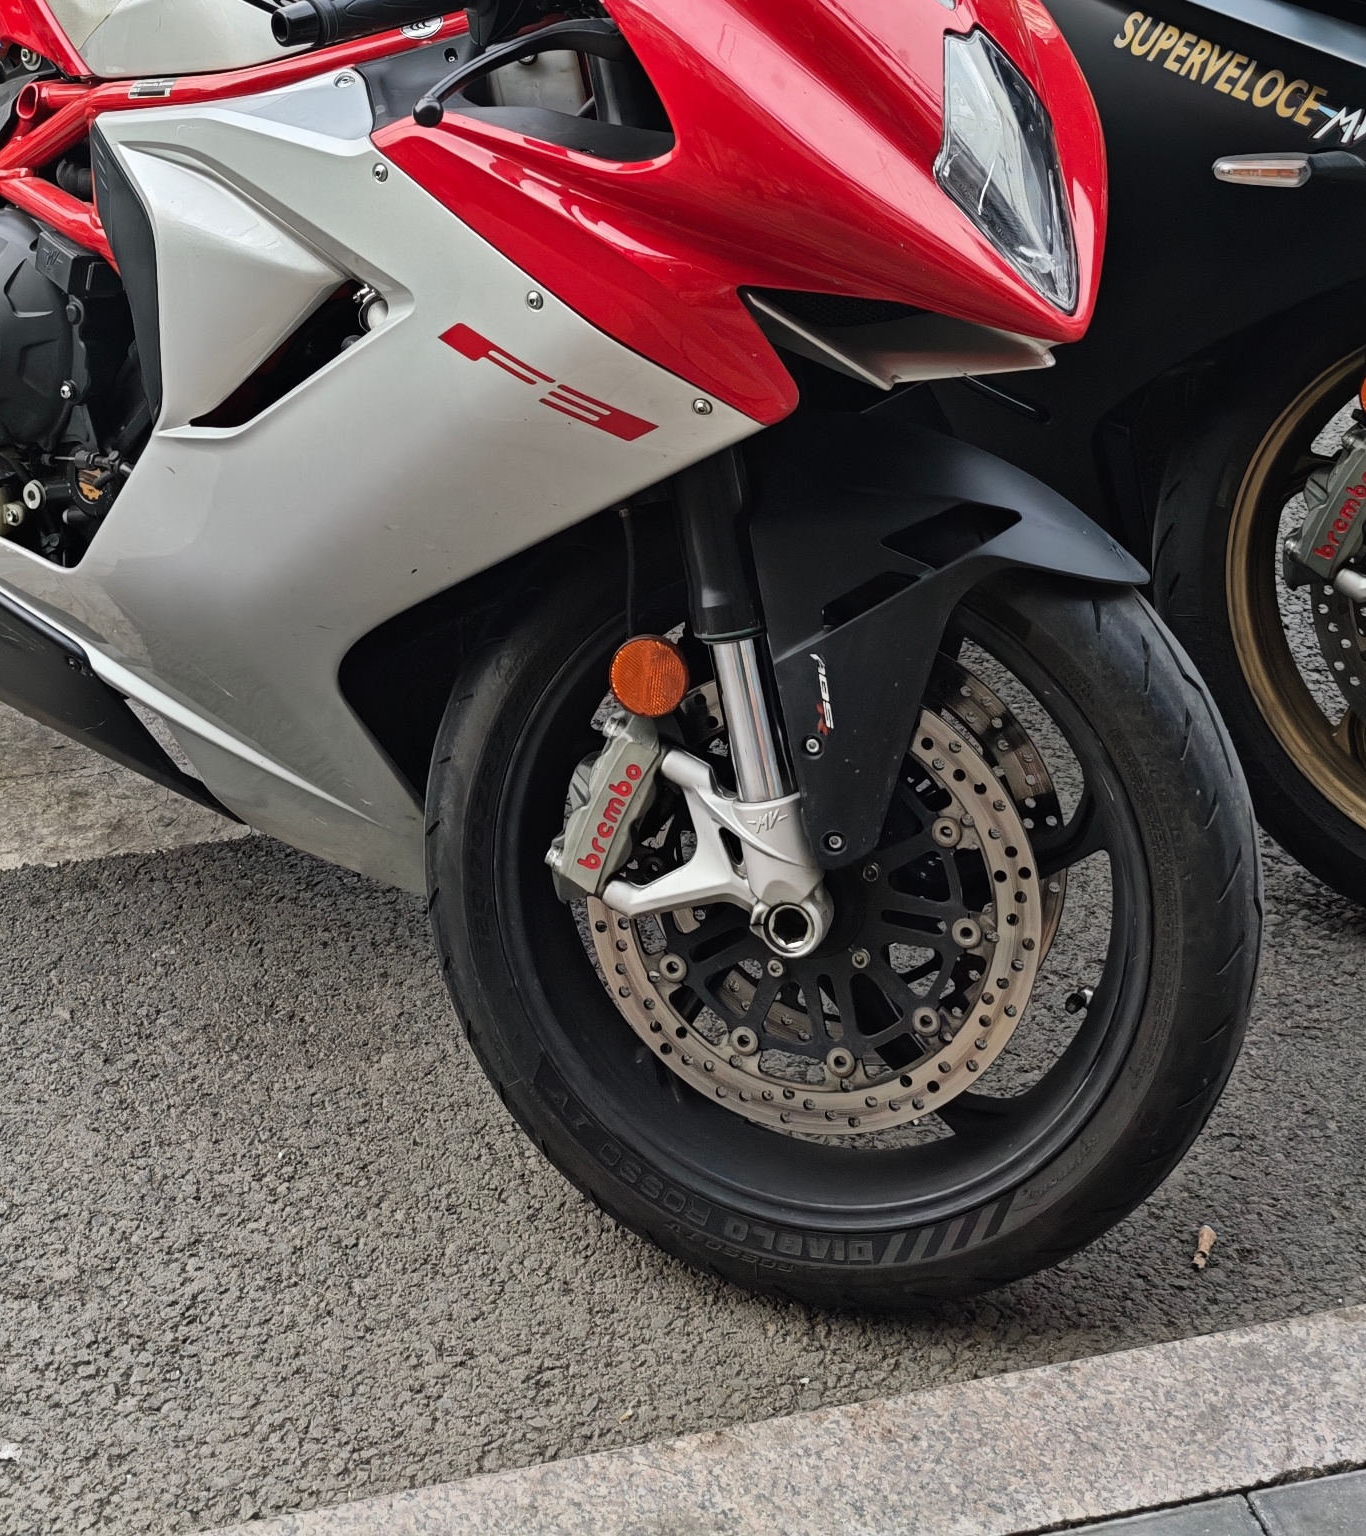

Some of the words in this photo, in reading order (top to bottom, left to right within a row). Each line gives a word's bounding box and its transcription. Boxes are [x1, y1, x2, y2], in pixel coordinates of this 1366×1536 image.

[1113, 10, 1328, 127] SUPERVELOCE
[436, 322, 660, 442] F3
[576, 763, 643, 871] brembo
[596, 1140, 710, 1228] ROSSO
[723, 1220, 875, 1263] DIABLO
